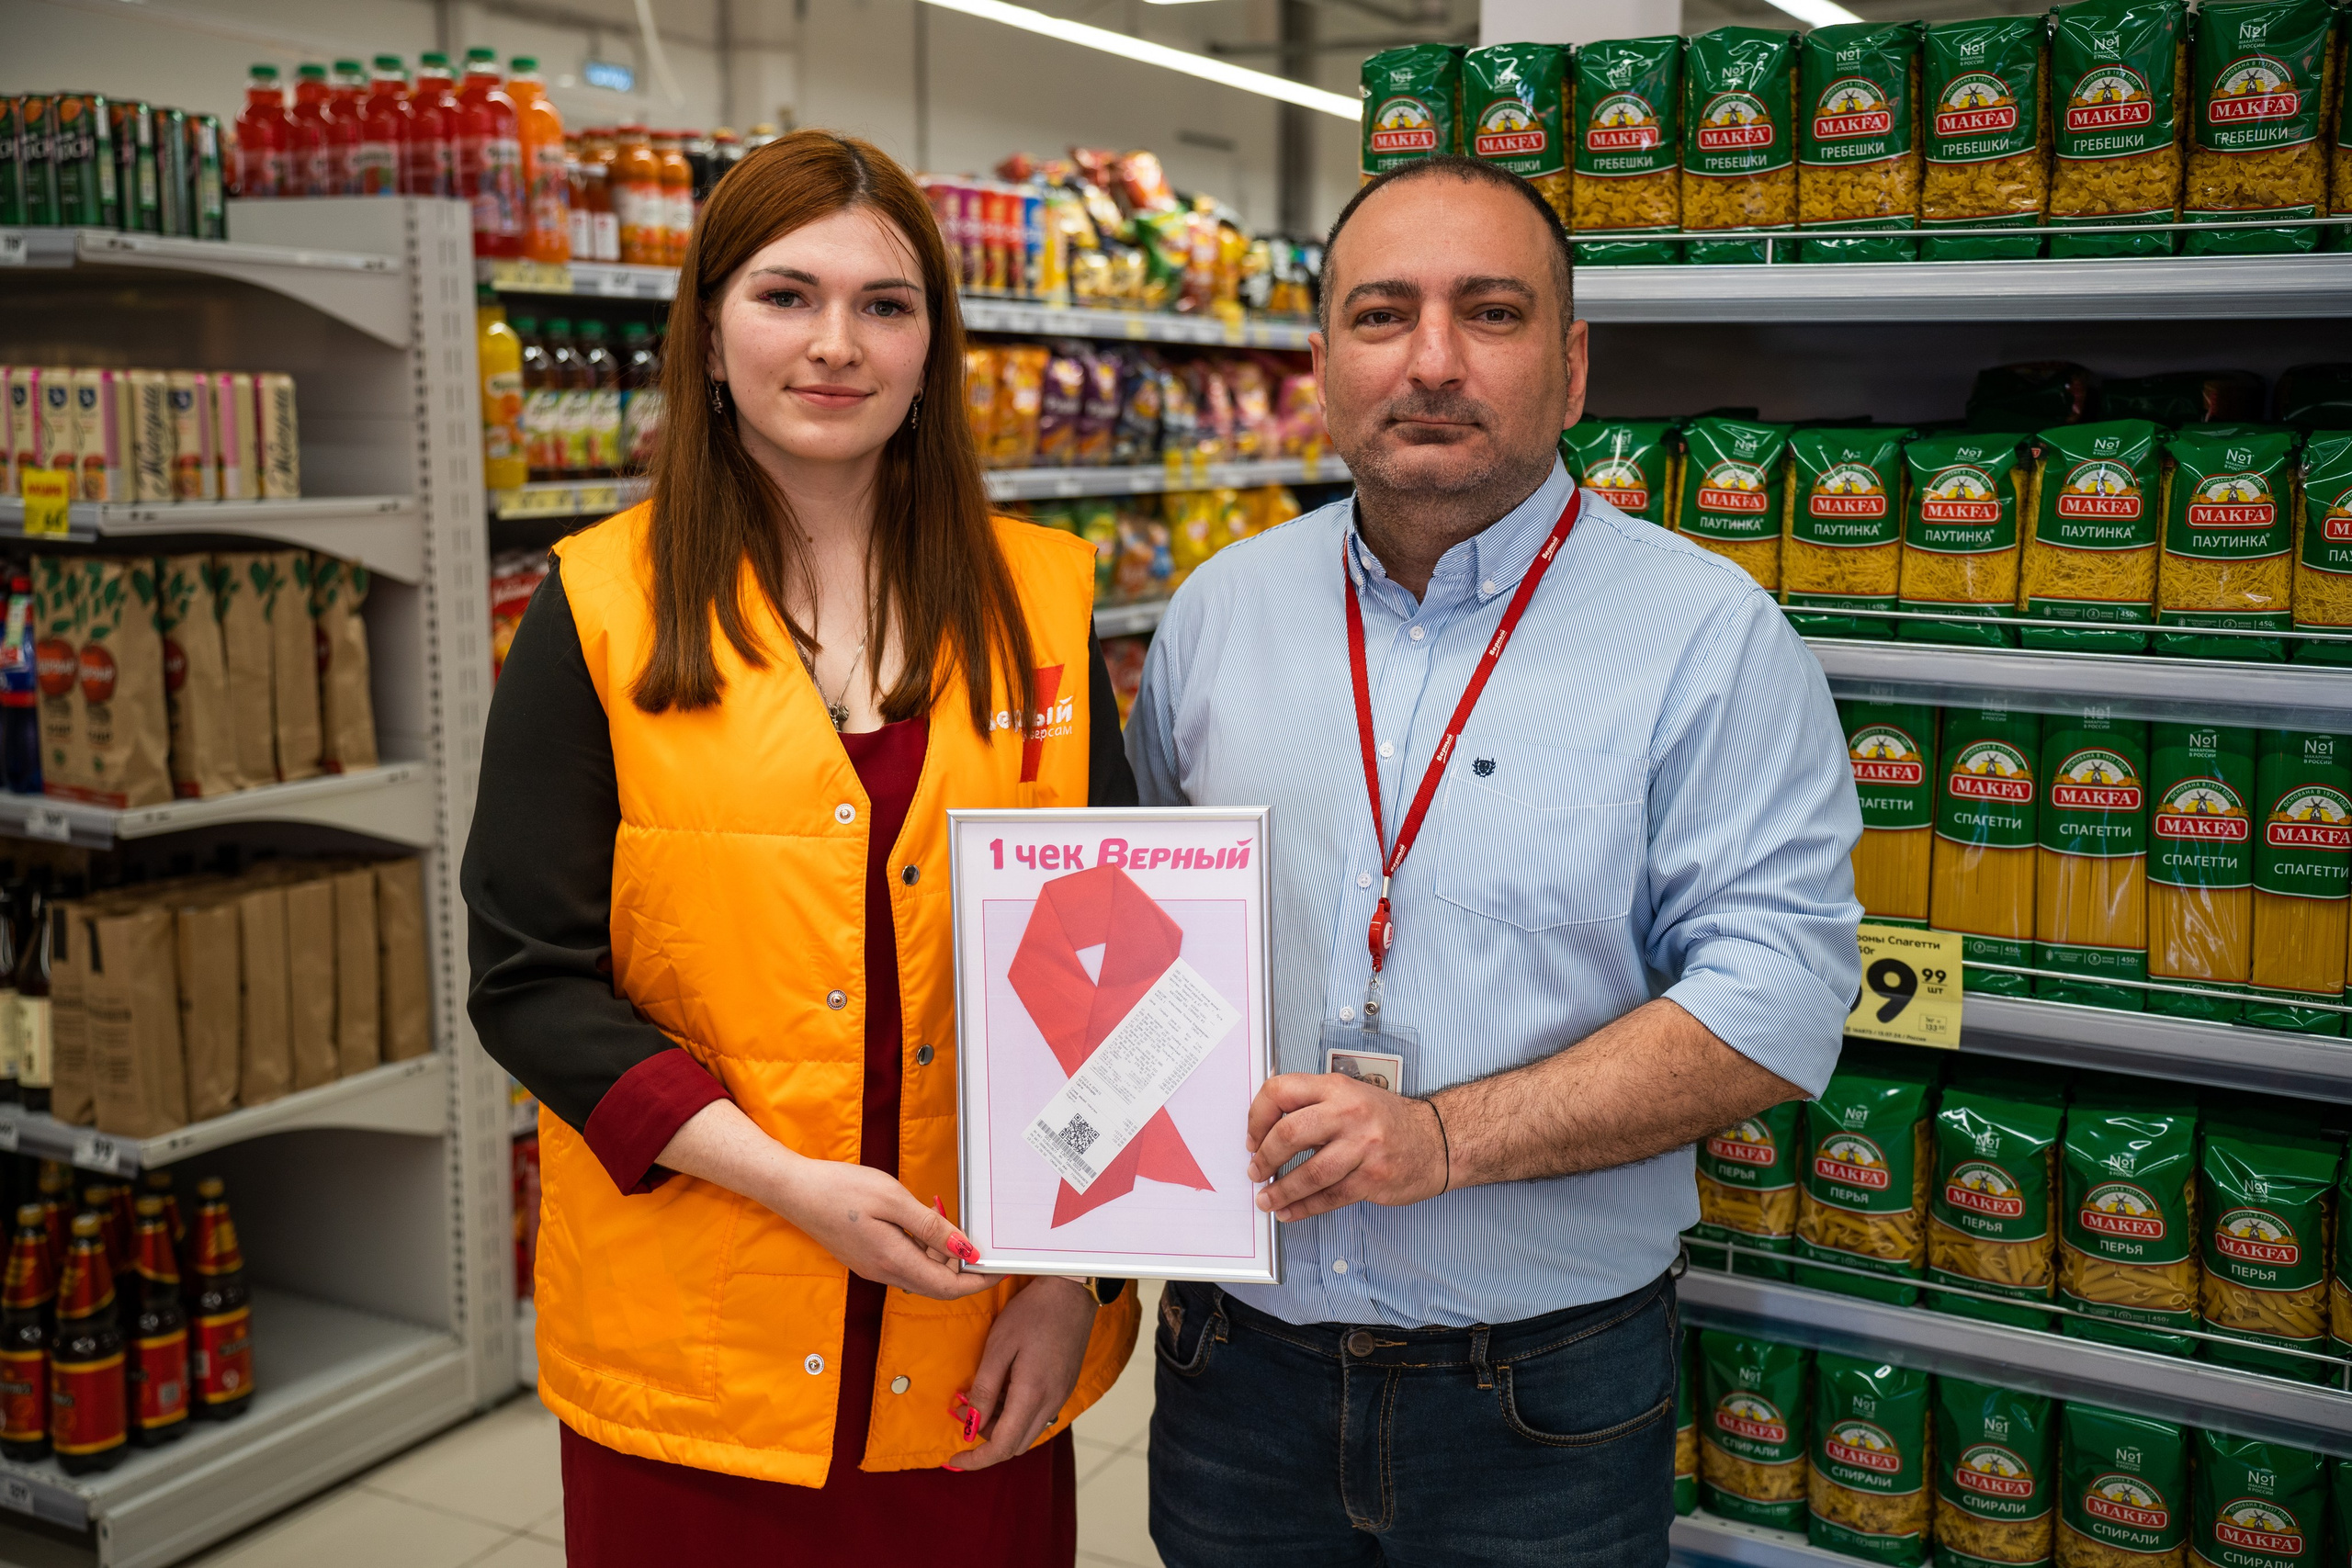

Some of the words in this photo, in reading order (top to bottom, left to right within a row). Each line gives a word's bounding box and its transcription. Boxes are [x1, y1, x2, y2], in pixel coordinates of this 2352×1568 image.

[2221, 62, 2250, 84] ОСНОВАНА
[2257, 61, 2272, 69] 1937
[2271, 65, 2286, 77] ГОДУ
[2215, 98, 2289, 118] MAKFA
[1941, 112, 2007, 130] MAKFA
[2074, 107, 2143, 126] MAKFA
[1820, 116, 1883, 134] MAKFA
[1376, 132, 1429, 147] MAKFA
[1481, 135, 1539, 151] MAKFA
[1593, 132, 1653, 145] MAKFA
[1703, 130, 1765, 144] MAKFA
[2074, 134, 2144, 152] ГРЕБЕШКИ
[2214, 127, 2288, 145] ГРЕБЕШКИ
[1821, 142, 1884, 159] ГРЕБЕШКИ
[1942, 139, 2009, 155] ГРЕБЕШКИ
[1593, 156, 1654, 170] ГРЕБЕШКИ
[1705, 154, 1768, 169] ГРЕБЕШКИ
[1704, 492, 1760, 508] MAKFA
[1816, 499, 1879, 513] MAKFA
[2065, 500, 2132, 513] MAKFA
[1927, 504, 1991, 518] MAKFA
[2196, 509, 2267, 522] MAKFA
[1700, 516, 1761, 531] ПАУТИНКА
[1815, 524, 1880, 536] ПАУТИНКА
[2061, 525, 2132, 538] ПАУТИНКА
[1925, 529, 1992, 542] ПАУТИНКА
[2192, 535, 2267, 547] ПАУТИНКА
[1542, 536, 1559, 560] Верный
[1488, 629, 1507, 657] Верный
[1436, 733, 1453, 762] Верный
[2189, 734, 2217, 748] №1
[2304, 739, 2333, 754] №1
[1956, 779, 2024, 797] MAKFA
[2169, 783, 2200, 800] ОСНОВАНА
[2208, 783, 2222, 791] 1937
[2222, 789, 2236, 802] ГОДУ
[2060, 790, 2132, 805] MAKFA
[2283, 789, 2315, 807] ОСНОВАНА
[2336, 796, 2349, 810] ГОДУ
[1954, 813, 2021, 829] СПАГЕТТИ
[2164, 819, 2239, 836] MAKFA
[2059, 824, 2132, 837] СПАГЕТТИ
[2276, 828, 2351, 843] MAKFA
[989, 839, 1003, 870] 1
[1015, 845, 1084, 870] чек
[2162, 854, 2237, 868] СПАГЕТТИ
[2274, 863, 2349, 878] СПАГЕТТИ
[1888, 936, 1940, 950] Спагетти
[1922, 968, 1947, 984] 99
[1927, 987, 1943, 995] шт
[1718, 1165, 1756, 1180] ПЕРЬЯ
[1821, 1161, 1882, 1184] MAKFA
[1830, 1187, 1869, 1204] ПЕРЬЯ
[1952, 1190, 2014, 1213] MAKFA
[1962, 1215, 2003, 1233] ПЕРЬЯ
[2088, 1215, 2154, 1235] MAKFA
[2100, 1240, 2143, 1255] ПЕРЬЯ
[2222, 1239, 2290, 1260] MAKFA
[2232, 1264, 2277, 1280] ПЕРЬЯ
[1723, 1416, 1779, 1439] MAKFA
[1723, 1436, 1780, 1457] СПИРАЛИ
[1832, 1444, 1892, 1468] MAKFA
[2116, 1449, 2141, 1464] №1
[1832, 1466, 1892, 1488] СПИРАЛИ
[1963, 1473, 2026, 1494] MAKFA
[2248, 1471, 2275, 1487] №1
[1962, 1495, 2026, 1514] СПИРАЛИ
[2093, 1501, 2159, 1525] MAKFA
[2093, 1523, 2159, 1544] СПИРАЛИ
[2223, 1528, 2294, 1551] MAKFA
[2223, 1551, 2294, 1568] СПИРАЛИ
